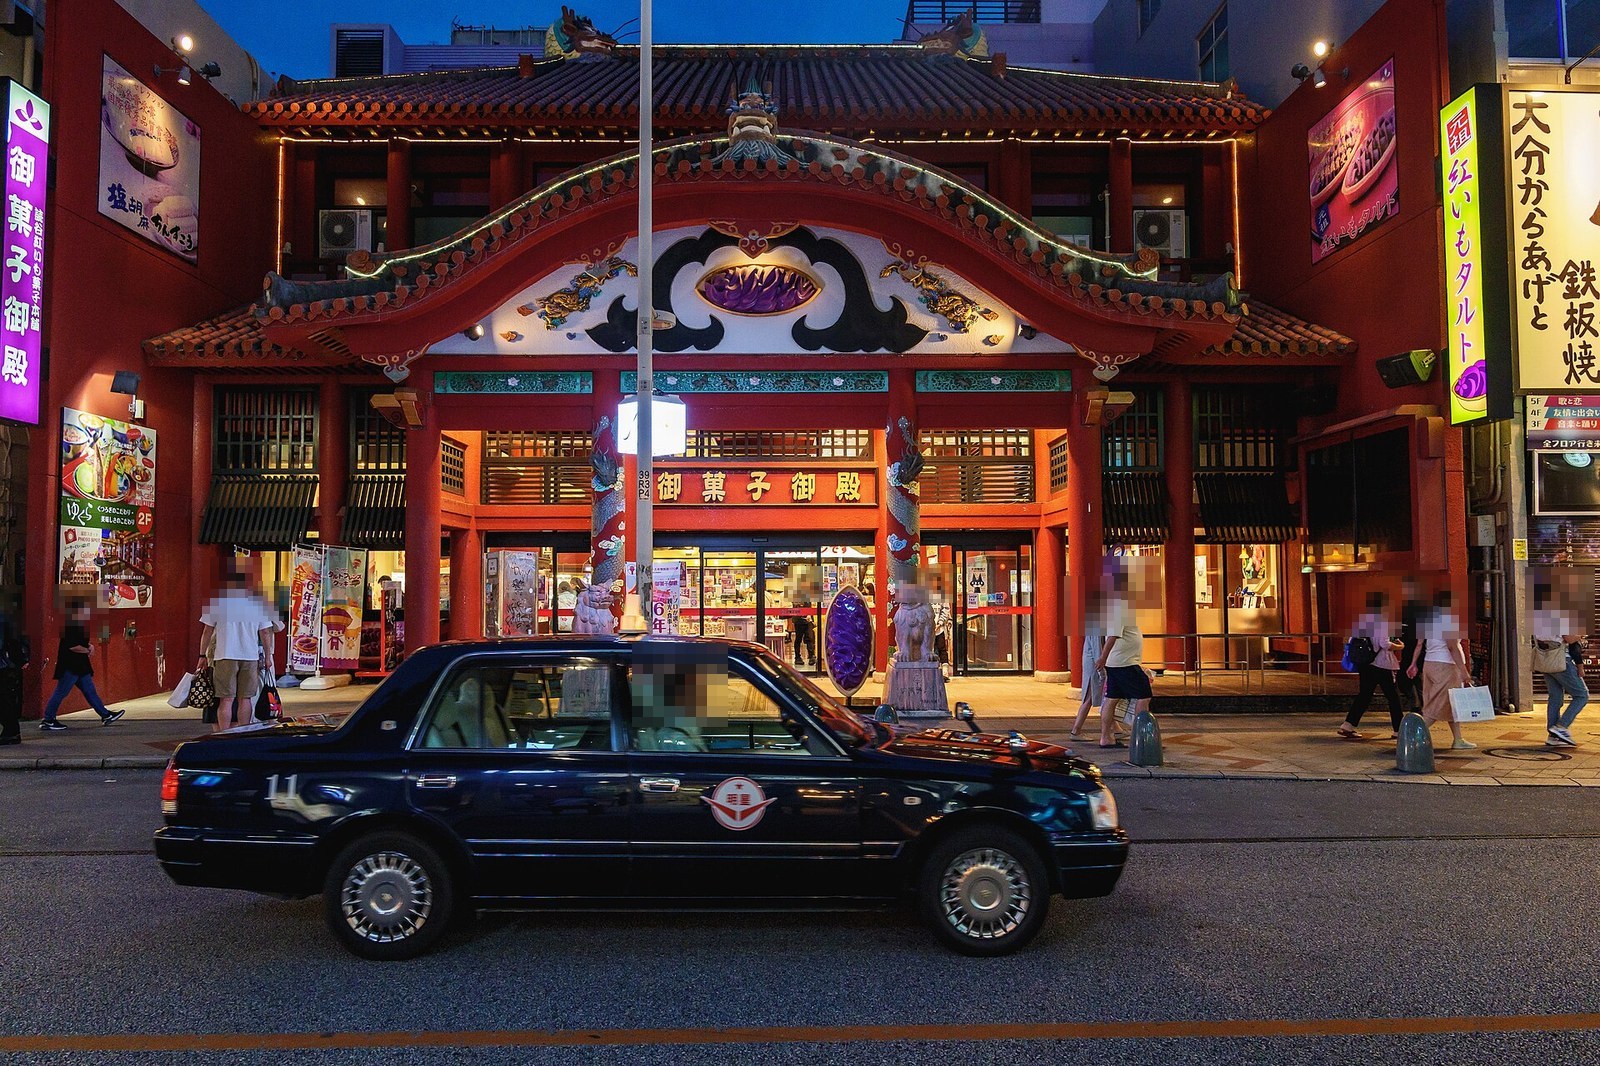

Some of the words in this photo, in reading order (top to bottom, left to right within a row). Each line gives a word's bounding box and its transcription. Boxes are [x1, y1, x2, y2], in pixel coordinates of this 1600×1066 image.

[1448, 111, 1472, 152] 元祖
[1511, 94, 1558, 331] 大分からあげと
[1, 145, 37, 387] 御菓子御殿
[1447, 158, 1476, 364] 紅いもタルト
[1556, 259, 1600, 386] 鉄板焼
[1530, 397, 1541, 405] 5F
[1557, 397, 1583, 405] 歌と恋
[1530, 408, 1541, 416] 4F
[1531, 420, 1541, 428] 3F
[1557, 420, 1598, 428] 音楽と踊り
[638, 470, 650, 479] 39
[638, 480, 650, 489] R3
[638, 489, 650, 498] P4
[657, 471, 862, 502] 御菓子御殿
[138, 512, 152, 526] 2F
[263, 774, 298, 800] 11
